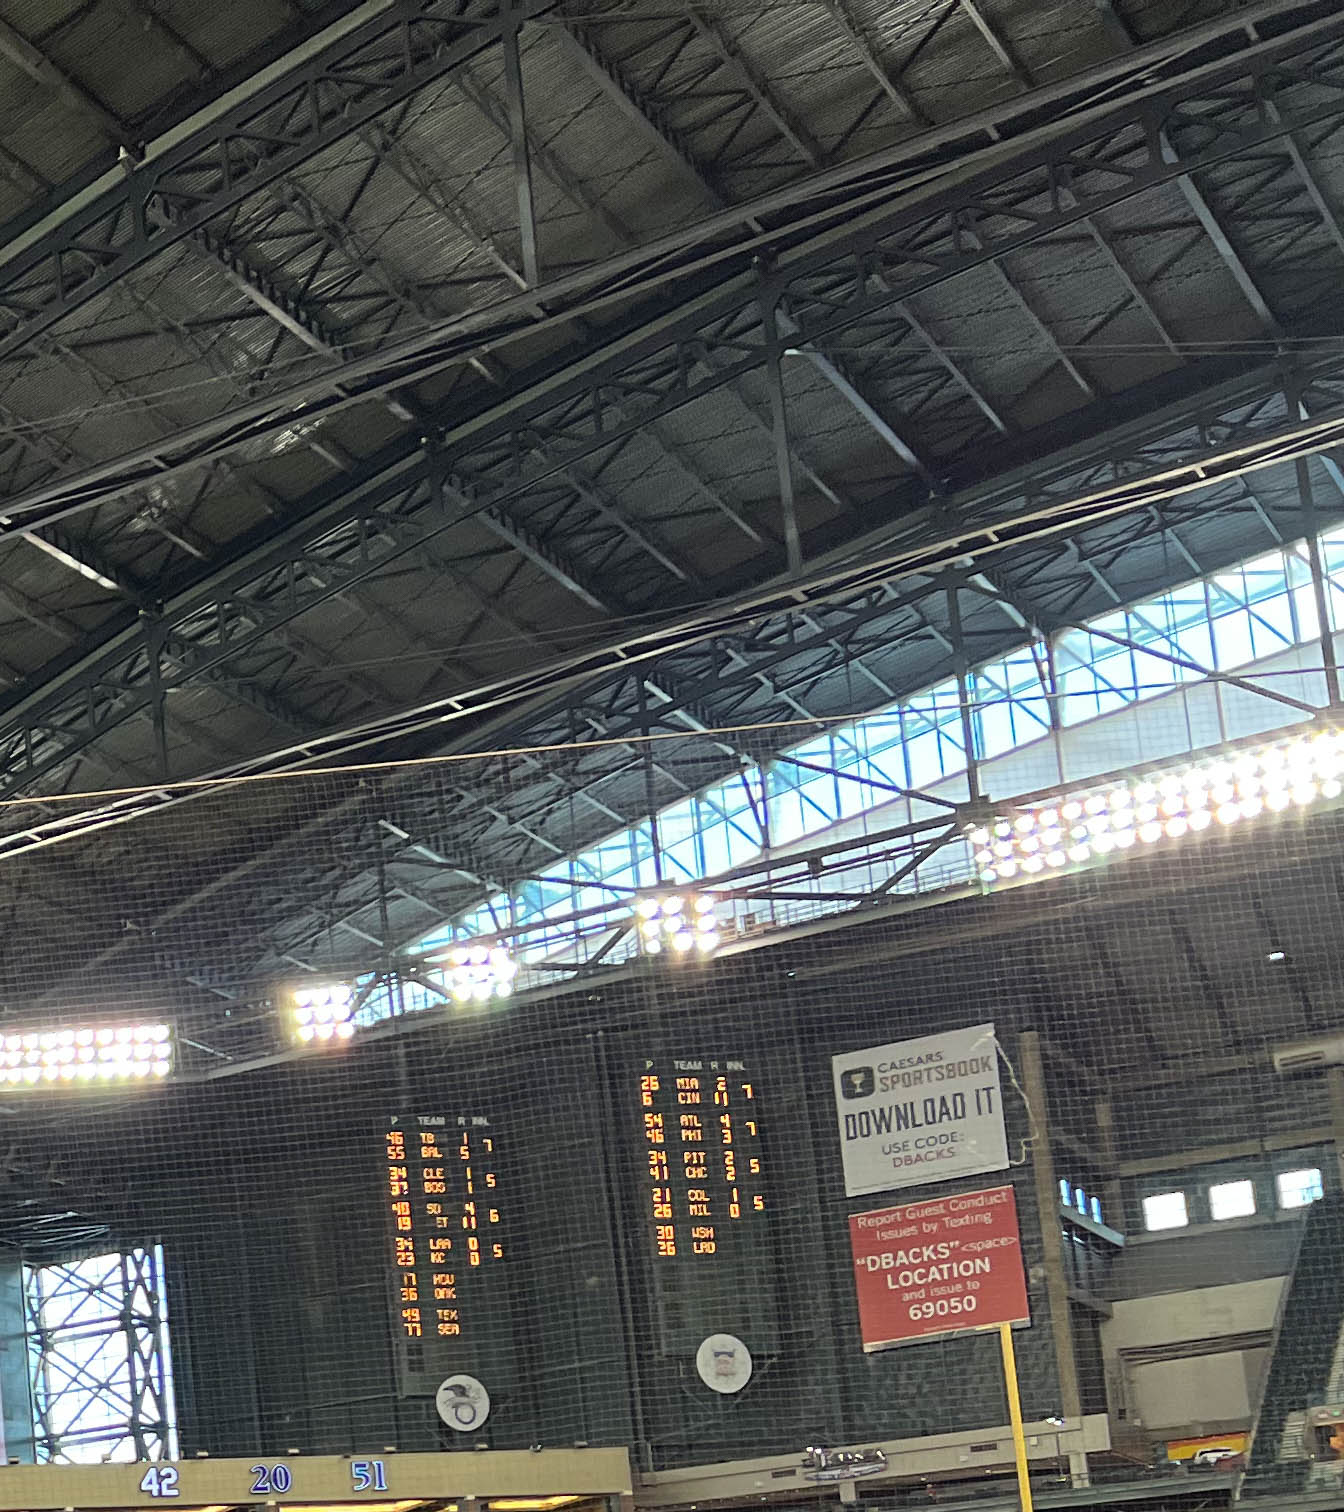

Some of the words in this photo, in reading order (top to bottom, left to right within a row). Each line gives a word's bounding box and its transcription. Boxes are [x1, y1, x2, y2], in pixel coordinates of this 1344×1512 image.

[878, 1051, 944, 1073] CAESARS
[880, 1055, 993, 1092] SPORTSBOOK
[845, 1092, 966, 1141] DOWNLOAD
[975, 1086, 994, 1115] IT
[881, 1140, 910, 1155] USE
[915, 1131, 965, 1149] CODE:
[893, 1147, 955, 1168] DBACKS
[858, 1213, 902, 1228] Report
[906, 1203, 945, 1219] Guest
[950, 1191, 1007, 1211] Conduct
[876, 1226, 918, 1241] Issues
[922, 1222, 938, 1233] by
[944, 1212, 993, 1228] Texting
[887, 1257, 990, 1290] LOCATION
[902, 1288, 925, 1301] and
[930, 1282, 962, 1297] issue
[967, 1280, 980, 1291] to
[909, 1295, 976, 1320] 69050
[140, 1466, 180, 1497] 42
[250, 1463, 291, 1494] 20
[352, 1460, 388, 1492] 51
